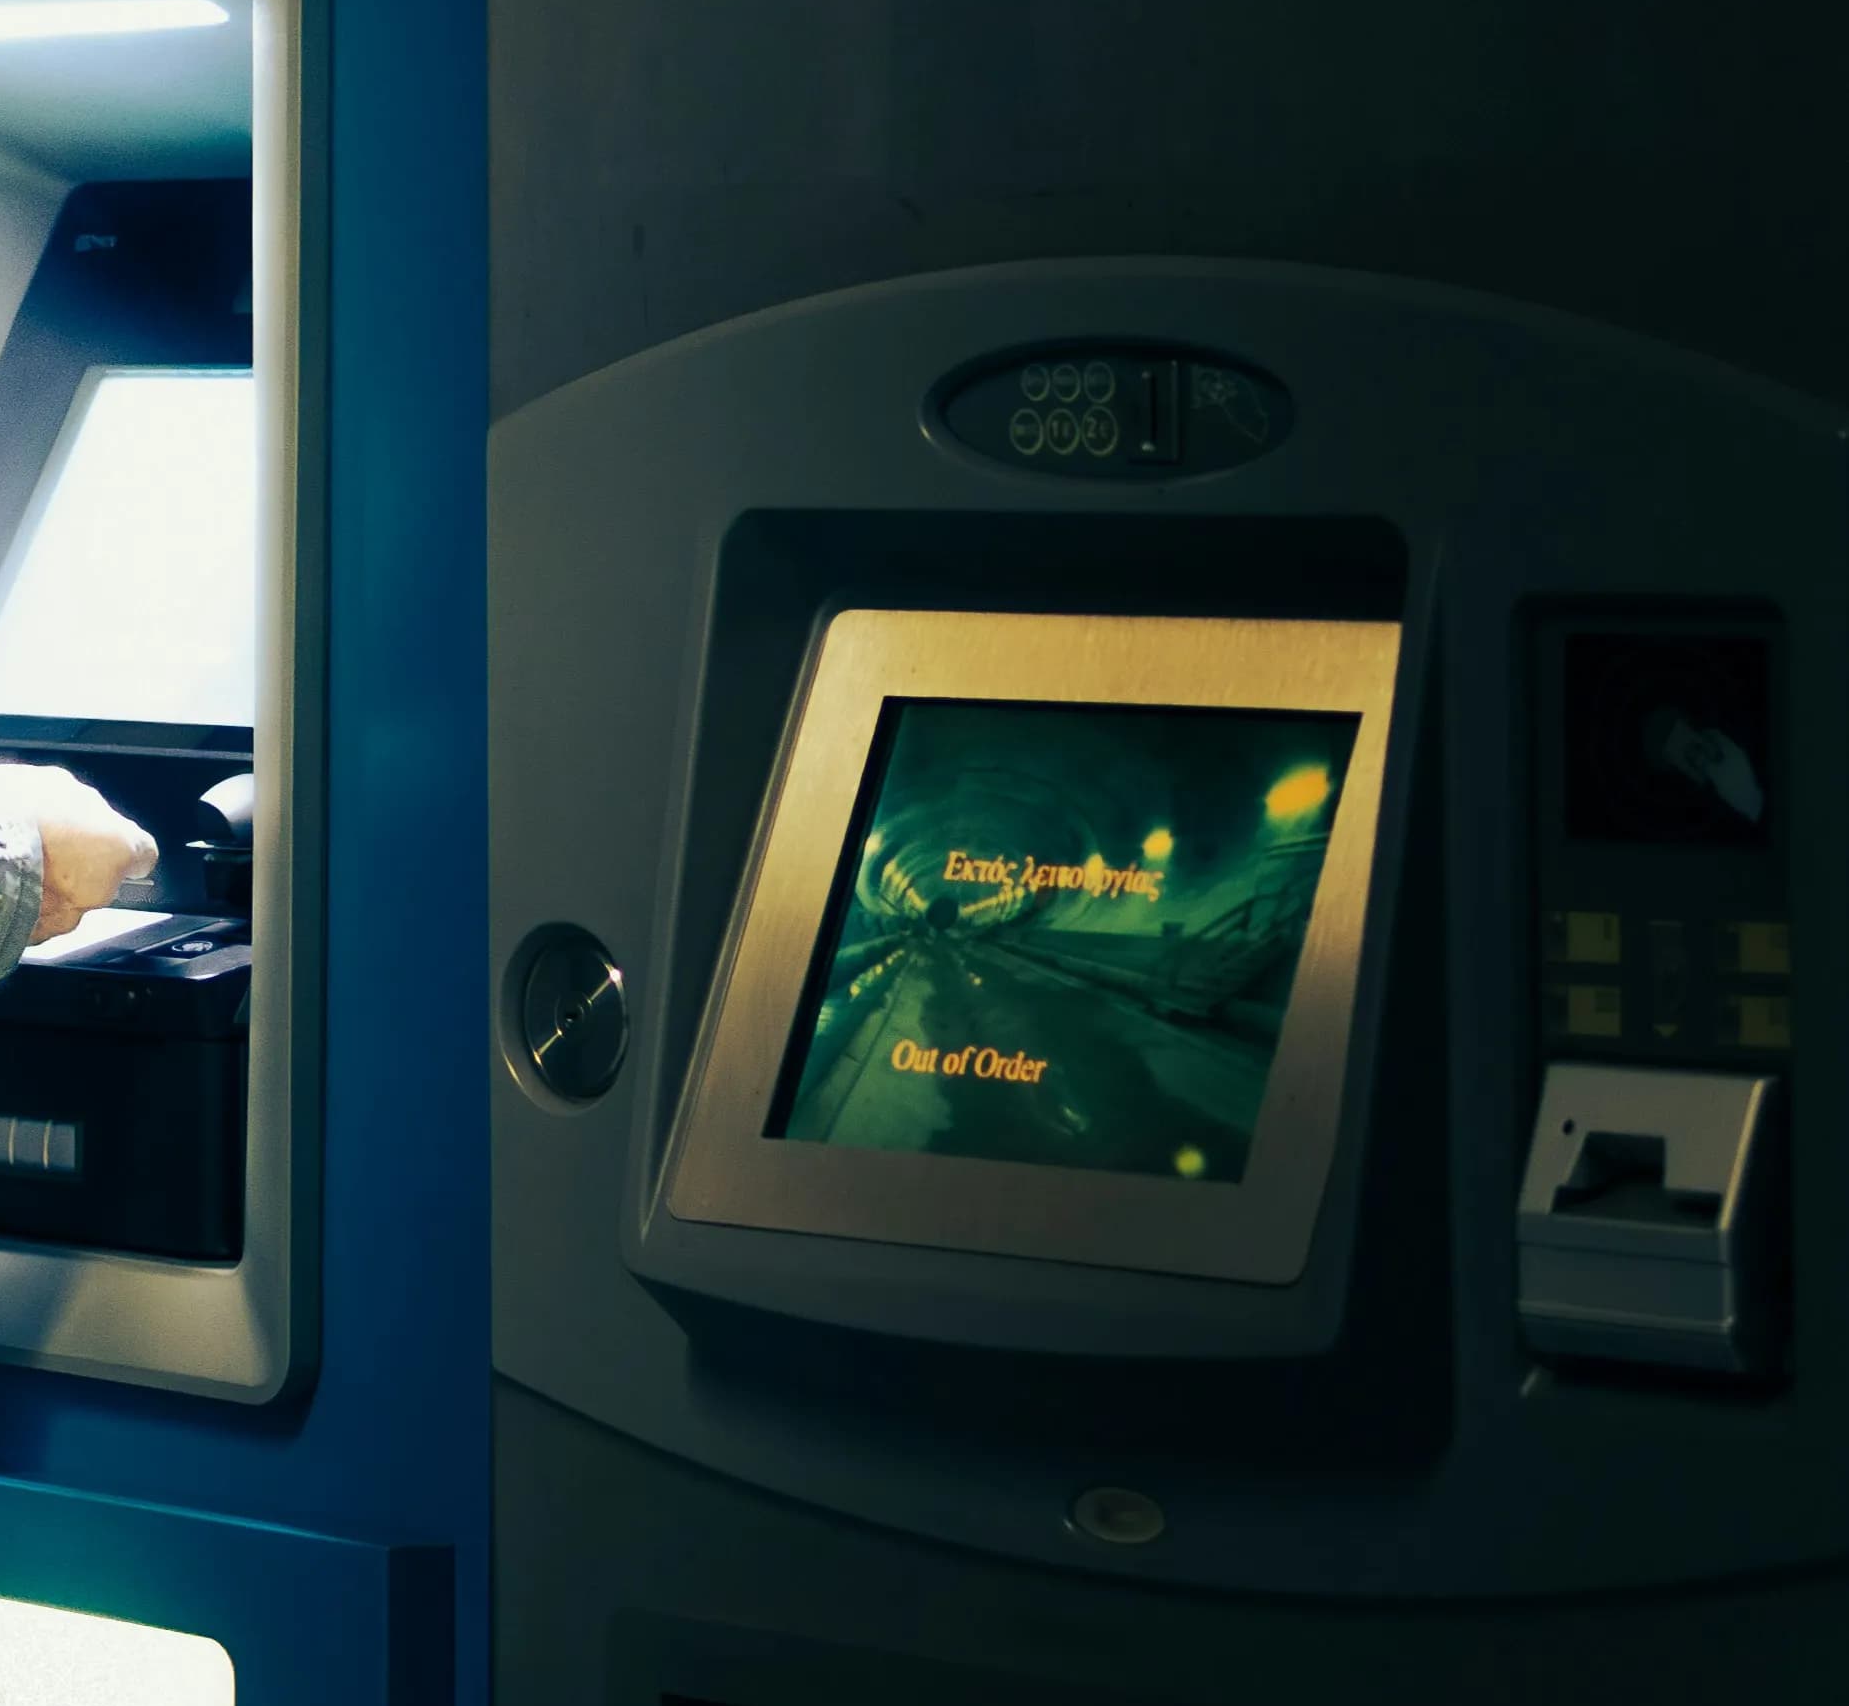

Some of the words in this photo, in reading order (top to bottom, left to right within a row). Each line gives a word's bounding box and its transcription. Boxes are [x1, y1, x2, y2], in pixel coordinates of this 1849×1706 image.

[943, 851, 1017, 888] Εκτός
[891, 1039, 938, 1074] Out
[943, 1046, 976, 1079] of
[974, 1047, 1046, 1084] Order
